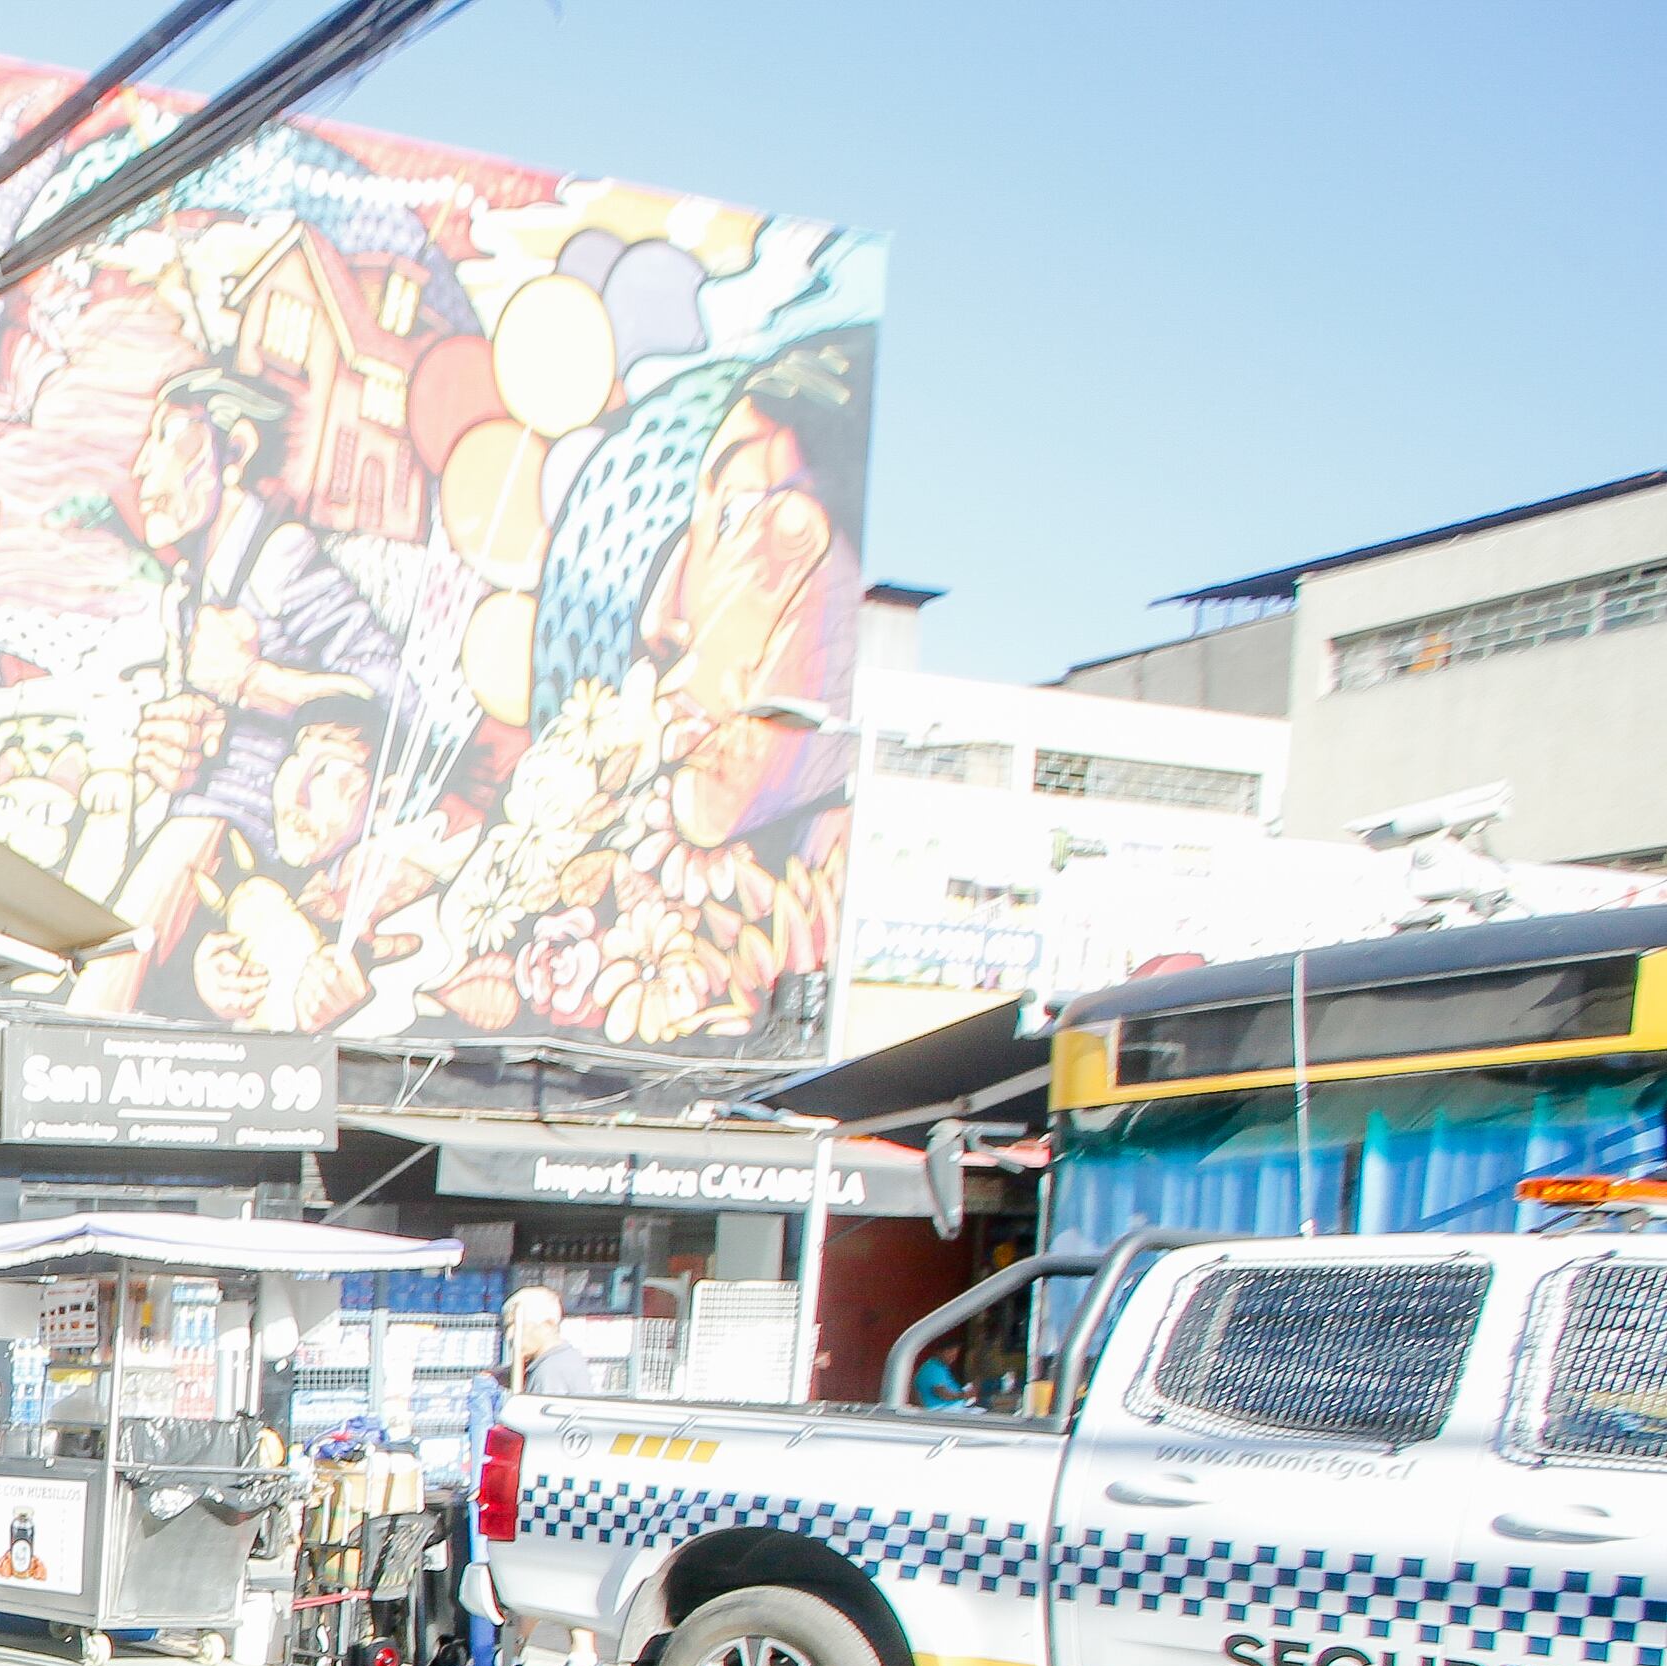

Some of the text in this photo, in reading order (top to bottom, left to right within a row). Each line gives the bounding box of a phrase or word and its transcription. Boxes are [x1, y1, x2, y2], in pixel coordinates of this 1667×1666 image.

[22, 1054, 322, 1112] San Alfonso 99
[699, 1164, 866, 1206] CAZABELA
[567, 1433, 589, 1450] 17
[1155, 1444, 1419, 1481] www.munistgo.cl
[3, 1485, 25, 1497] CON
